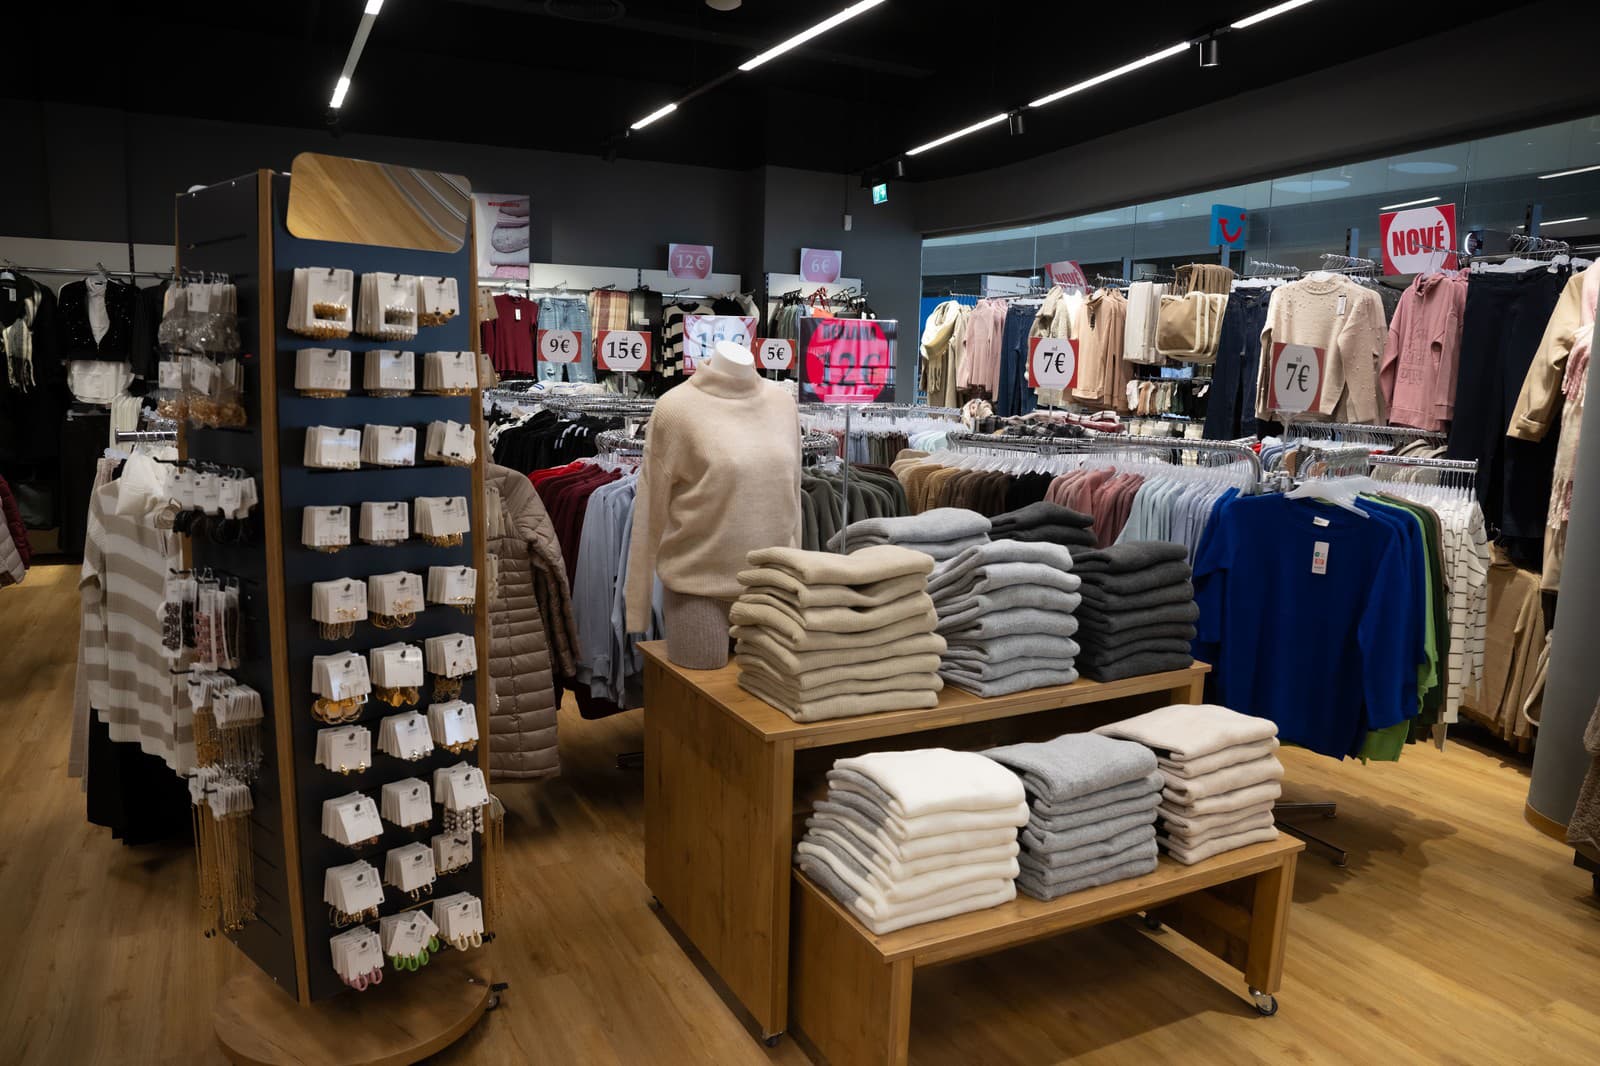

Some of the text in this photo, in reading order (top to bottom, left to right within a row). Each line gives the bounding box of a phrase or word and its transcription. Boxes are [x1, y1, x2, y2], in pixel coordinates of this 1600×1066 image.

[1391, 221, 1445, 257] NOVÉ
[676, 254, 706, 271] 12€
[811, 258, 831, 273] 6€
[549, 338, 570, 354] 9€
[606, 341, 643, 360] 15€
[767, 346, 785, 361] 5€
[819, 352, 882, 388] 12€
[1043, 351, 1066, 374] 7€
[1285, 362, 1311, 393] 7€
